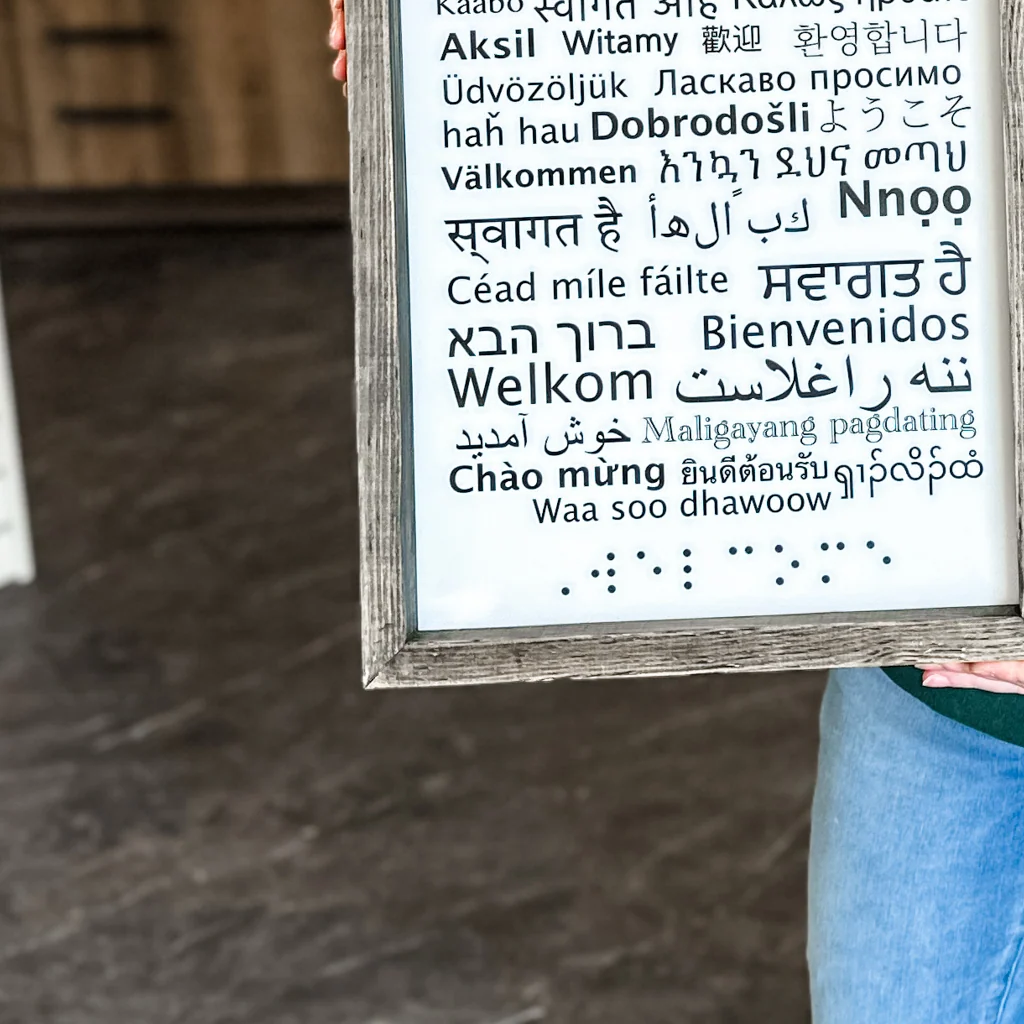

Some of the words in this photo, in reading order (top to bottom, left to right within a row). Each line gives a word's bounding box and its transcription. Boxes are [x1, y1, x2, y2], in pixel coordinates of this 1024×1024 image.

[440, 28, 534, 61] Aksil
[562, 28, 678, 56] Witamy
[702, 25, 761, 54] 歡迎
[794, 18, 967, 57] 환영합니다
[443, 71, 628, 106] Üdvözöljük
[655, 69, 795, 96] Ласкаво
[811, 65, 961, 96] просимо
[520, 117, 578, 144] hau
[592, 102, 809, 140] Dobrodošli
[821, 95, 971, 133] ようこそ
[441, 163, 636, 190] Välkommen
[840, 180, 971, 227] Nnọọ
[448, 272, 535, 304] Céad
[553, 268, 625, 299] míle
[640, 265, 727, 296] fáilte
[449, 325, 537, 357] הבא
[557, 320, 655, 362] ברוך
[704, 305, 969, 350] Bienvenidos
[448, 362, 652, 408] Welkom
[544, 417, 631, 456] خوش
[642, 415, 817, 449] Maligayang
[831, 407, 976, 444] pagdating
[450, 462, 542, 493] Chào
[559, 457, 664, 491] mừng
[682, 452, 827, 485] ยินดีต้อนรับ
[533, 498, 598, 523] Waa
[612, 499, 666, 520] soo
[681, 489, 831, 517] dhawoow
